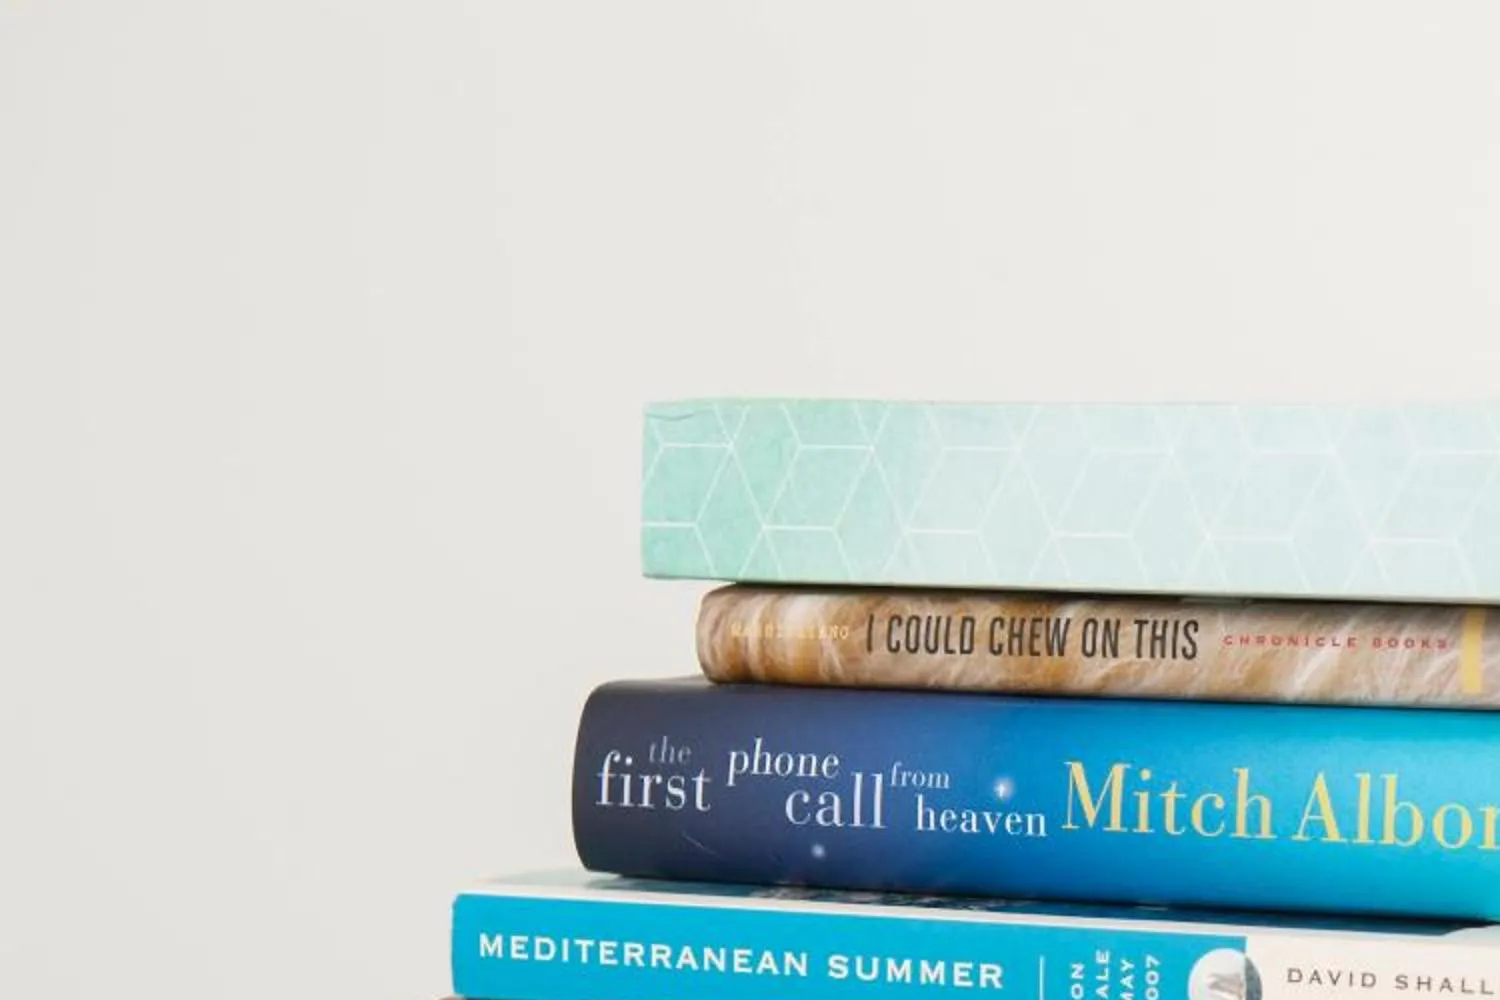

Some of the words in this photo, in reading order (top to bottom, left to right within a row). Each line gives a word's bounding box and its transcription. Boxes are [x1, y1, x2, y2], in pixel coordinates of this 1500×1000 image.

[866, 614, 875, 653] I
[886, 616, 976, 656] COULD
[989, 616, 1071, 657] CHEW
[1082, 618, 1121, 659] ON
[1133, 620, 1199, 660] THIS
[1222, 634, 1357, 649] CHRONICLE
[1371, 638, 1451, 651] BOOKS
[648, 735, 692, 765] the
[726, 737, 840, 787] phone
[595, 749, 712, 812] first
[890, 761, 951, 790] from
[785, 771, 888, 829] call
[916, 793, 1048, 838] heaven
[1062, 761, 1277, 839] Mitch
[479, 932, 809, 977] MEDITERRANEAN
[827, 954, 1004, 989] SUMMER
[1070, 962, 1085, 1000] ON
[1287, 967, 1378, 989] DAVID
